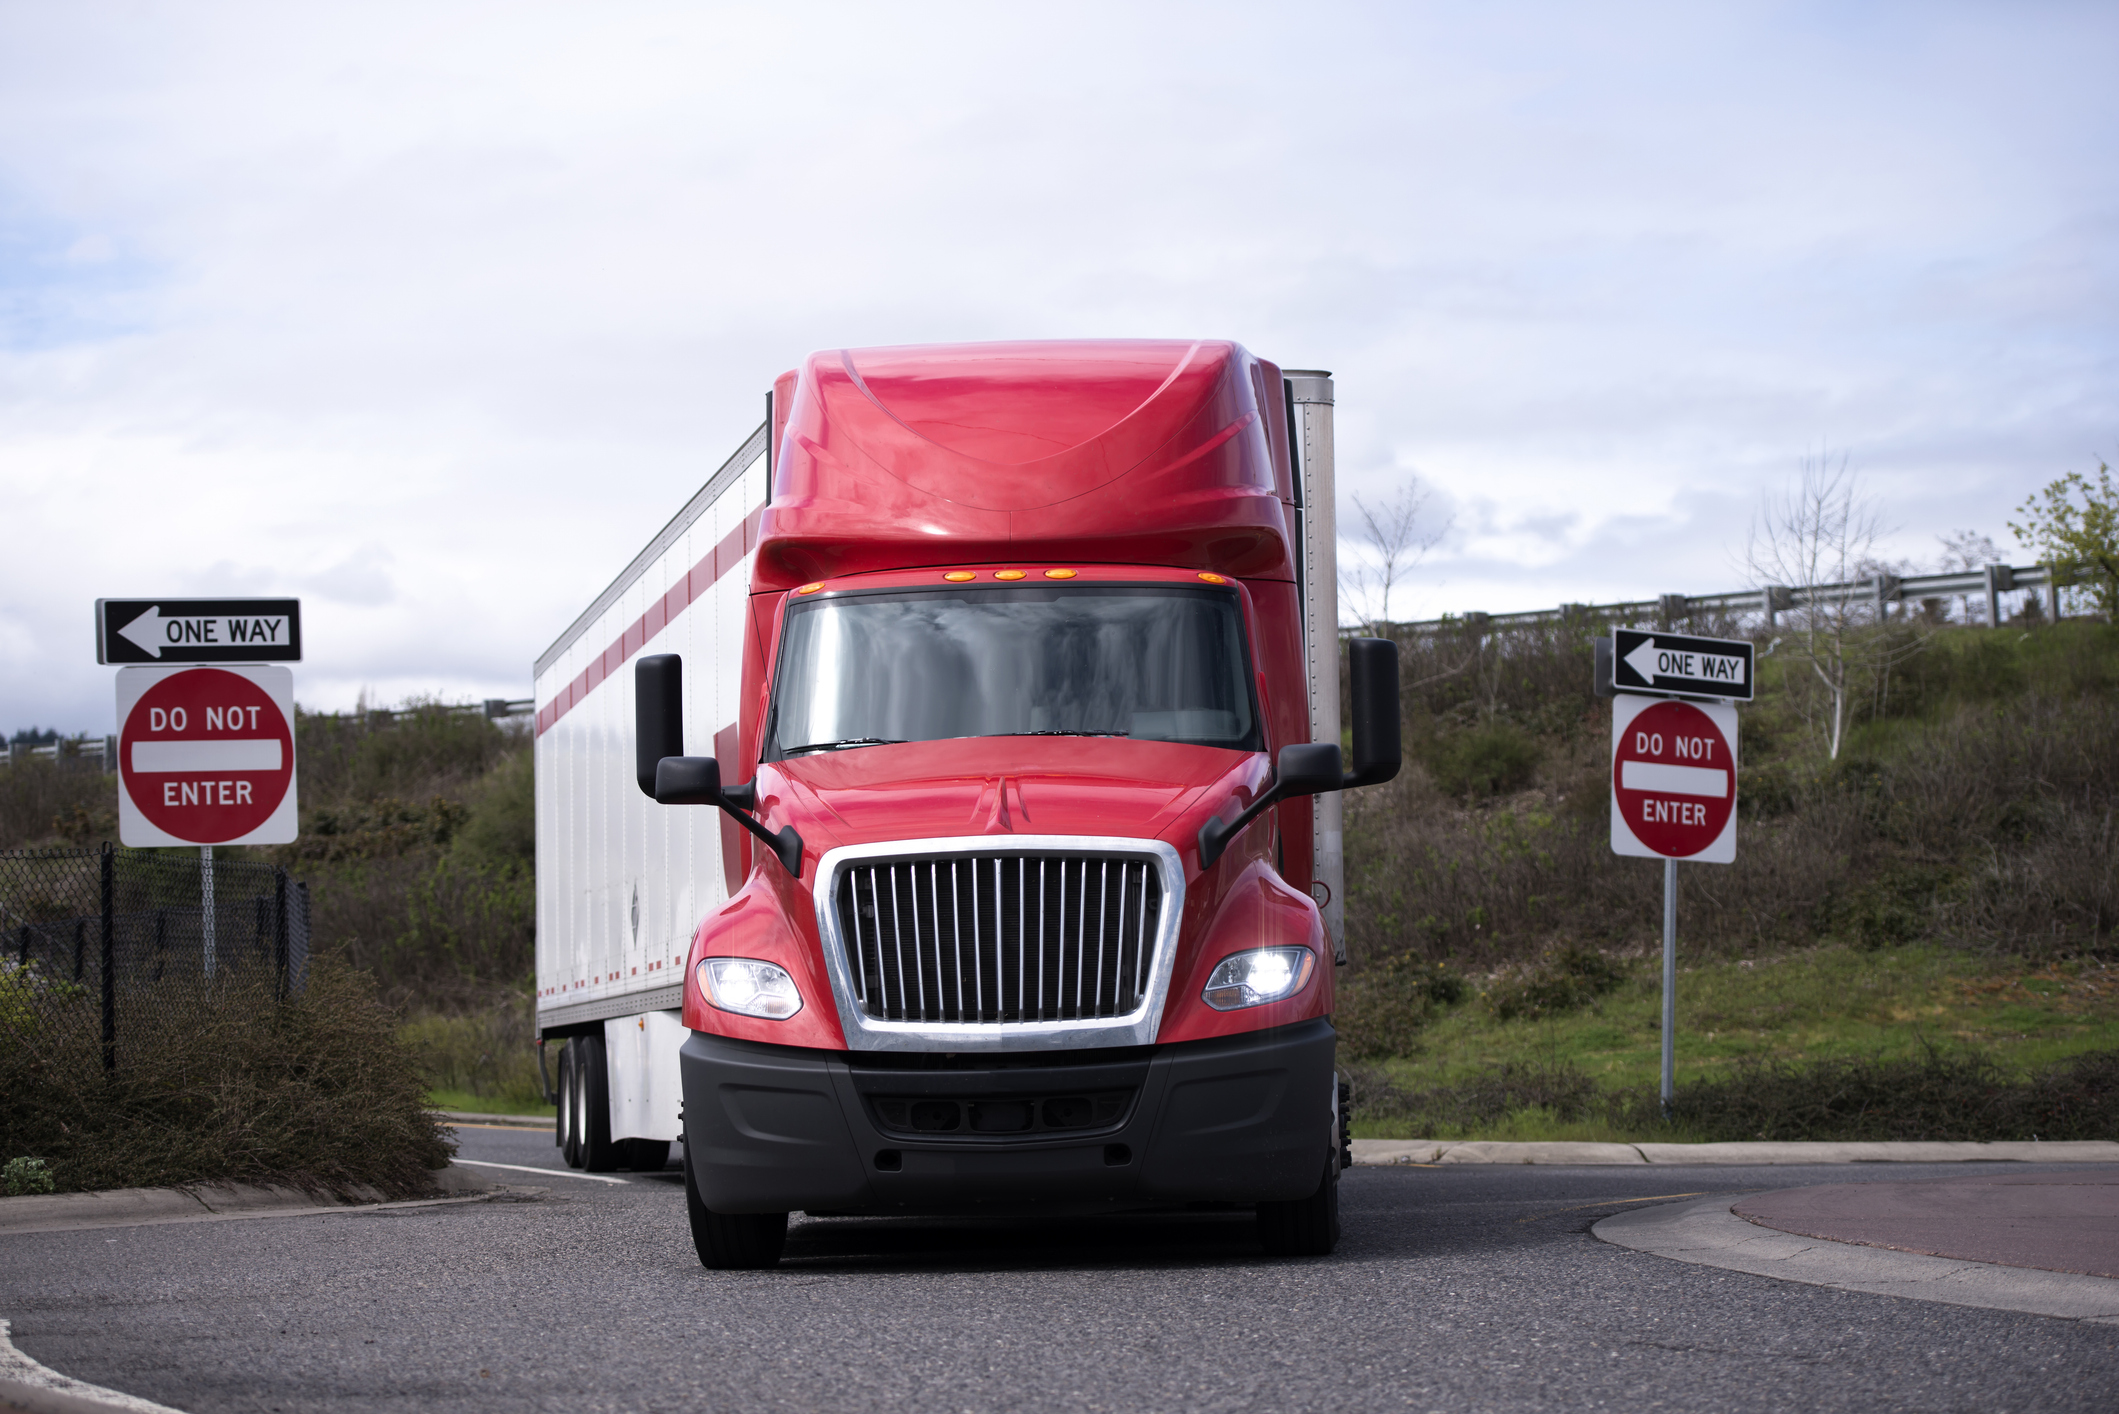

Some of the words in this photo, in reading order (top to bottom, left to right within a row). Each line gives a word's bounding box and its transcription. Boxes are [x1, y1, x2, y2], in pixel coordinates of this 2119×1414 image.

[166, 619, 218, 643] ONE
[228, 618, 282, 642] WAY
[1658, 652, 1695, 676] ONE
[1702, 656, 1739, 680] WAY
[150, 707, 188, 732] DO
[206, 706, 261, 731] NOT
[1636, 731, 1663, 756] DO
[1675, 735, 1715, 761] NOT
[163, 780, 253, 806] ENTER
[1643, 799, 1706, 826] ENTER
